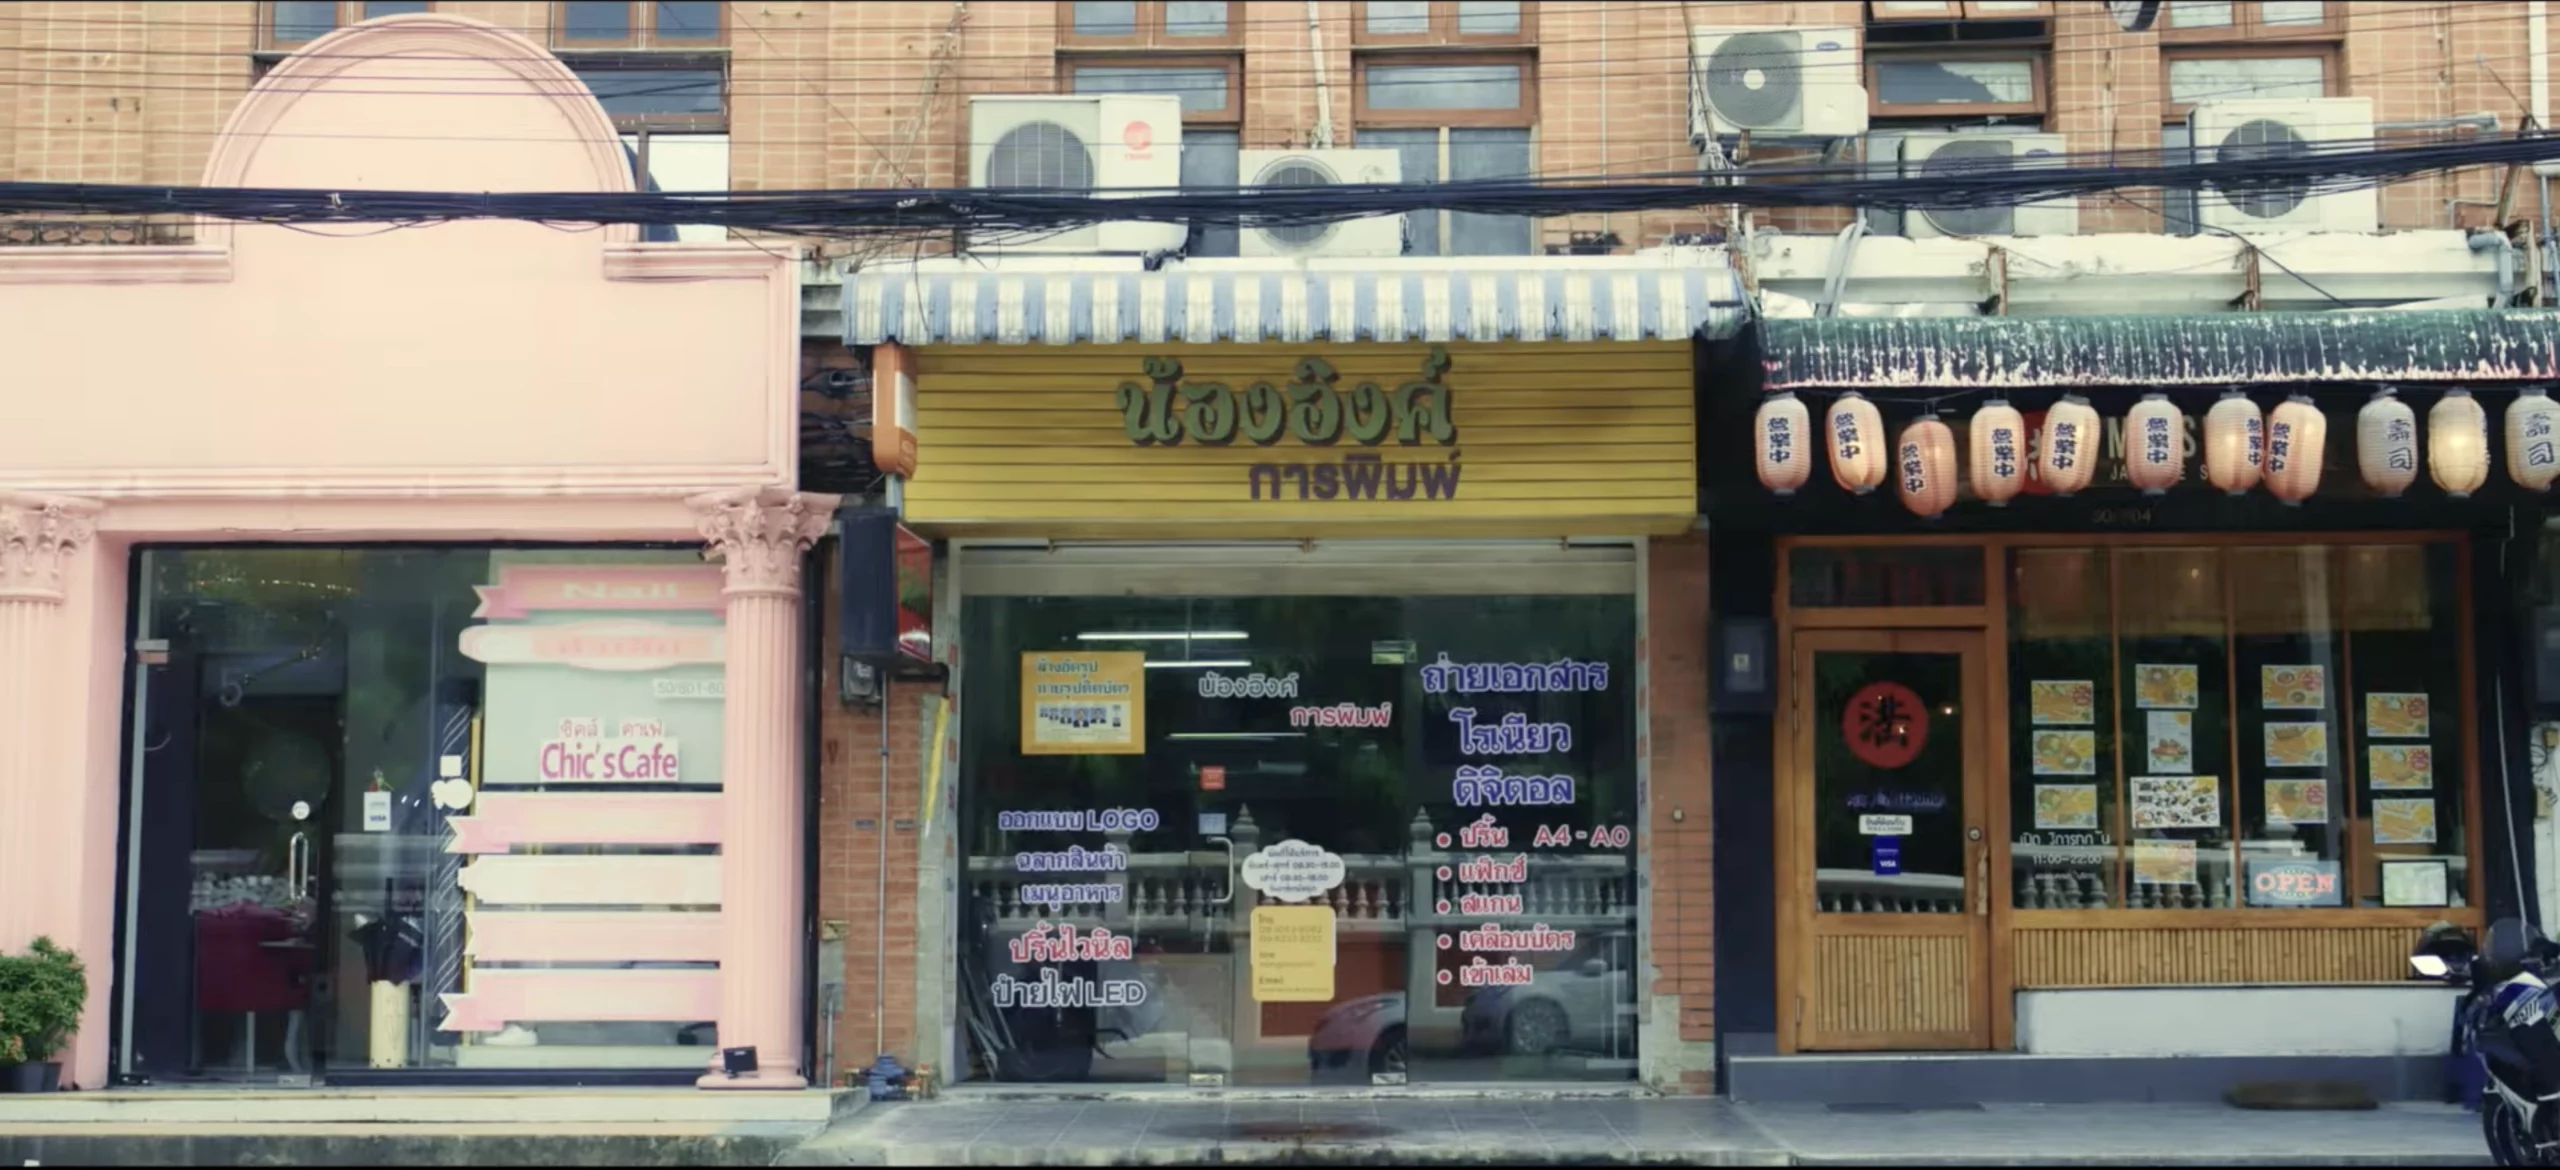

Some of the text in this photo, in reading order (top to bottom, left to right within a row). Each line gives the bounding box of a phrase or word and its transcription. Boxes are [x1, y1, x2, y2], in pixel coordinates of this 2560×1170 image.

[1116, 344, 1459, 445] น้องอิงค์
[1249, 450, 1462, 500] การพิมพ์
[563, 582, 678, 600] Nail
[1199, 673, 1299, 698] น้องอิงค์
[1421, 652, 1608, 692] ถ่ายเอกสาร
[1290, 702, 1391, 727] การพิมพ์
[1450, 708, 1571, 753] โรเนียว
[542, 743, 677, 779] Chic's Cafe
[1454, 765, 1574, 805] ดิจิตอล
[1000, 809, 1159, 831] ออกแบบ LOGO
[1461, 813, 1508, 847] ปริ้น
[1533, 825, 1572, 847] A4
[1590, 825, 1631, 847] A0
[1016, 844, 1127, 871] ฉลากสินค้า
[1879, 860, 1897, 868] VISA
[1021, 884, 1124, 910] เมนูอาหาร
[2255, 872, 2337, 894] OPEN
[1460, 893, 1523, 914] สแกน
[1010, 920, 1133, 962] ปริ้นไวนิล
[1460, 923, 1575, 950] เคลือบบัตร
[1460, 956, 1533, 985] เข้าเล่ม
[992, 967, 1147, 1007] ป้ายไฟ LED
